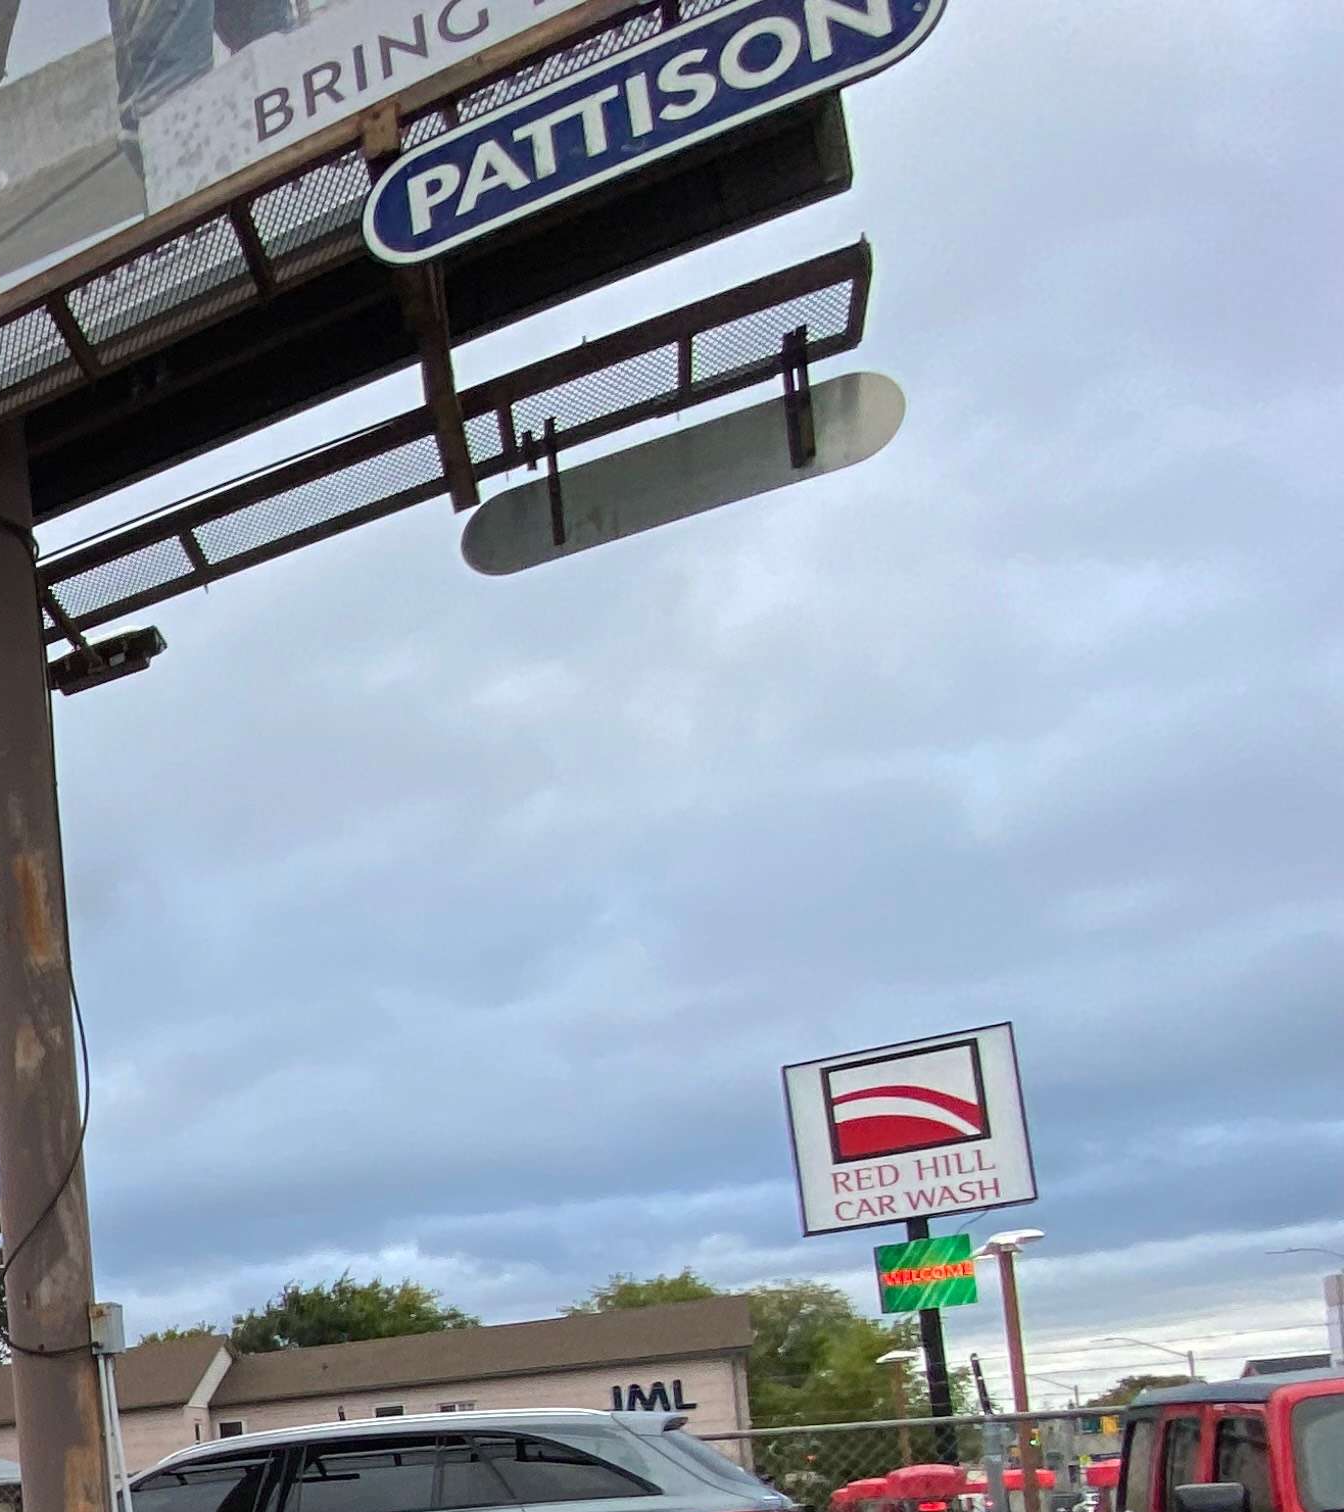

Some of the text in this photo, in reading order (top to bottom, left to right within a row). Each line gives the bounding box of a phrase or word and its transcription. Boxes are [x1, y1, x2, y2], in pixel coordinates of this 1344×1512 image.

[254, 0, 489, 143] BRING
[407, 0, 892, 236] PATTISON
[832, 1149, 996, 1194] RED HILL
[835, 1178, 1001, 1222] CAR WASH
[882, 1260, 974, 1286] WELCOME
[612, 1379, 698, 1411] IML
